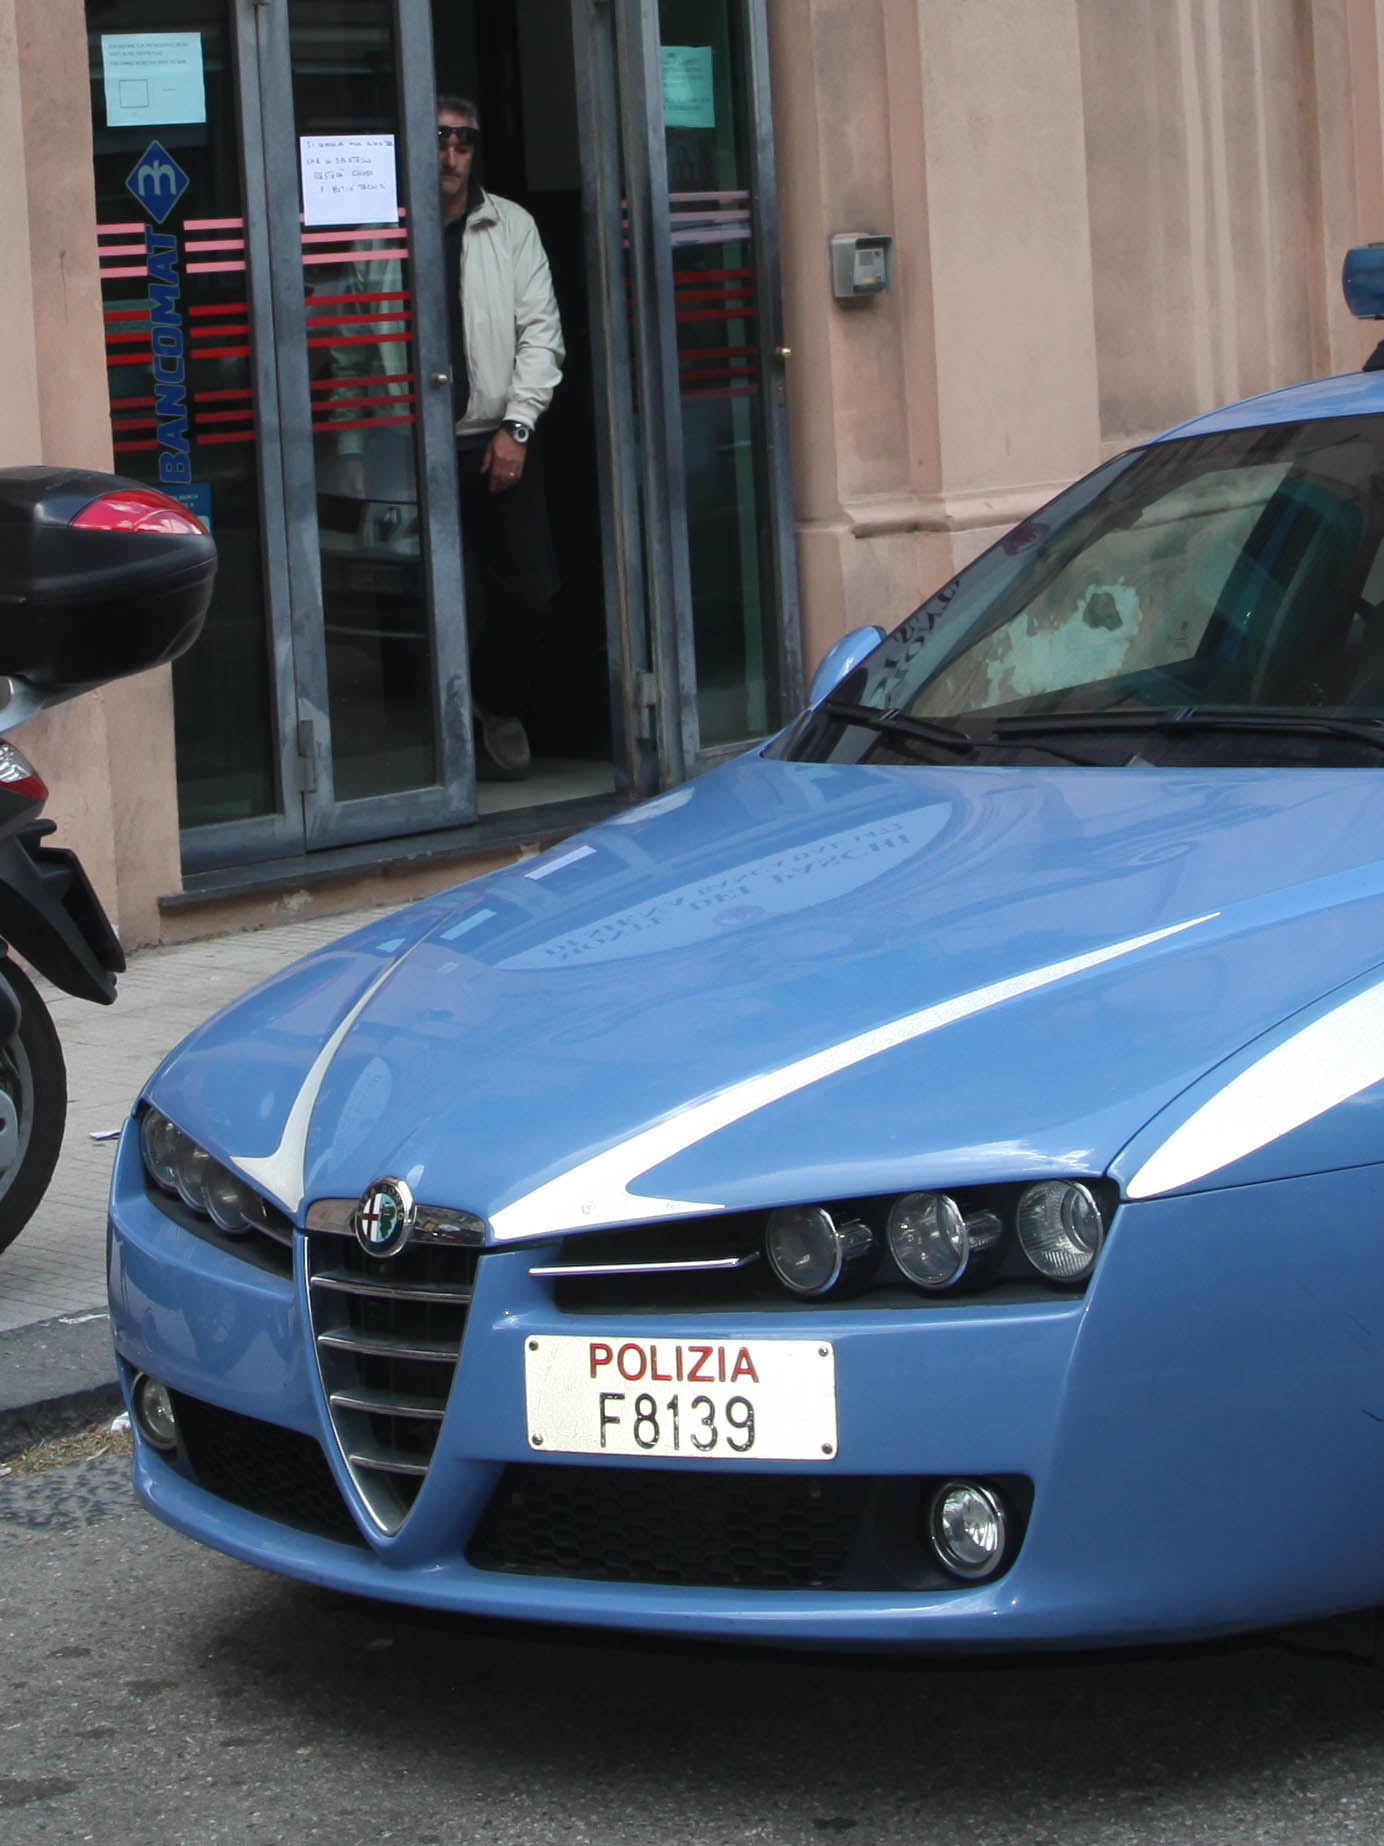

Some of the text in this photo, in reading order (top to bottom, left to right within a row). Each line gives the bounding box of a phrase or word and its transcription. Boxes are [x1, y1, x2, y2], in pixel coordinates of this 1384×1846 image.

[145, 224, 192, 484] BANCOMAT
[589, 1343, 759, 1382] POLIZIA
[600, 1393, 755, 1452] F8139
